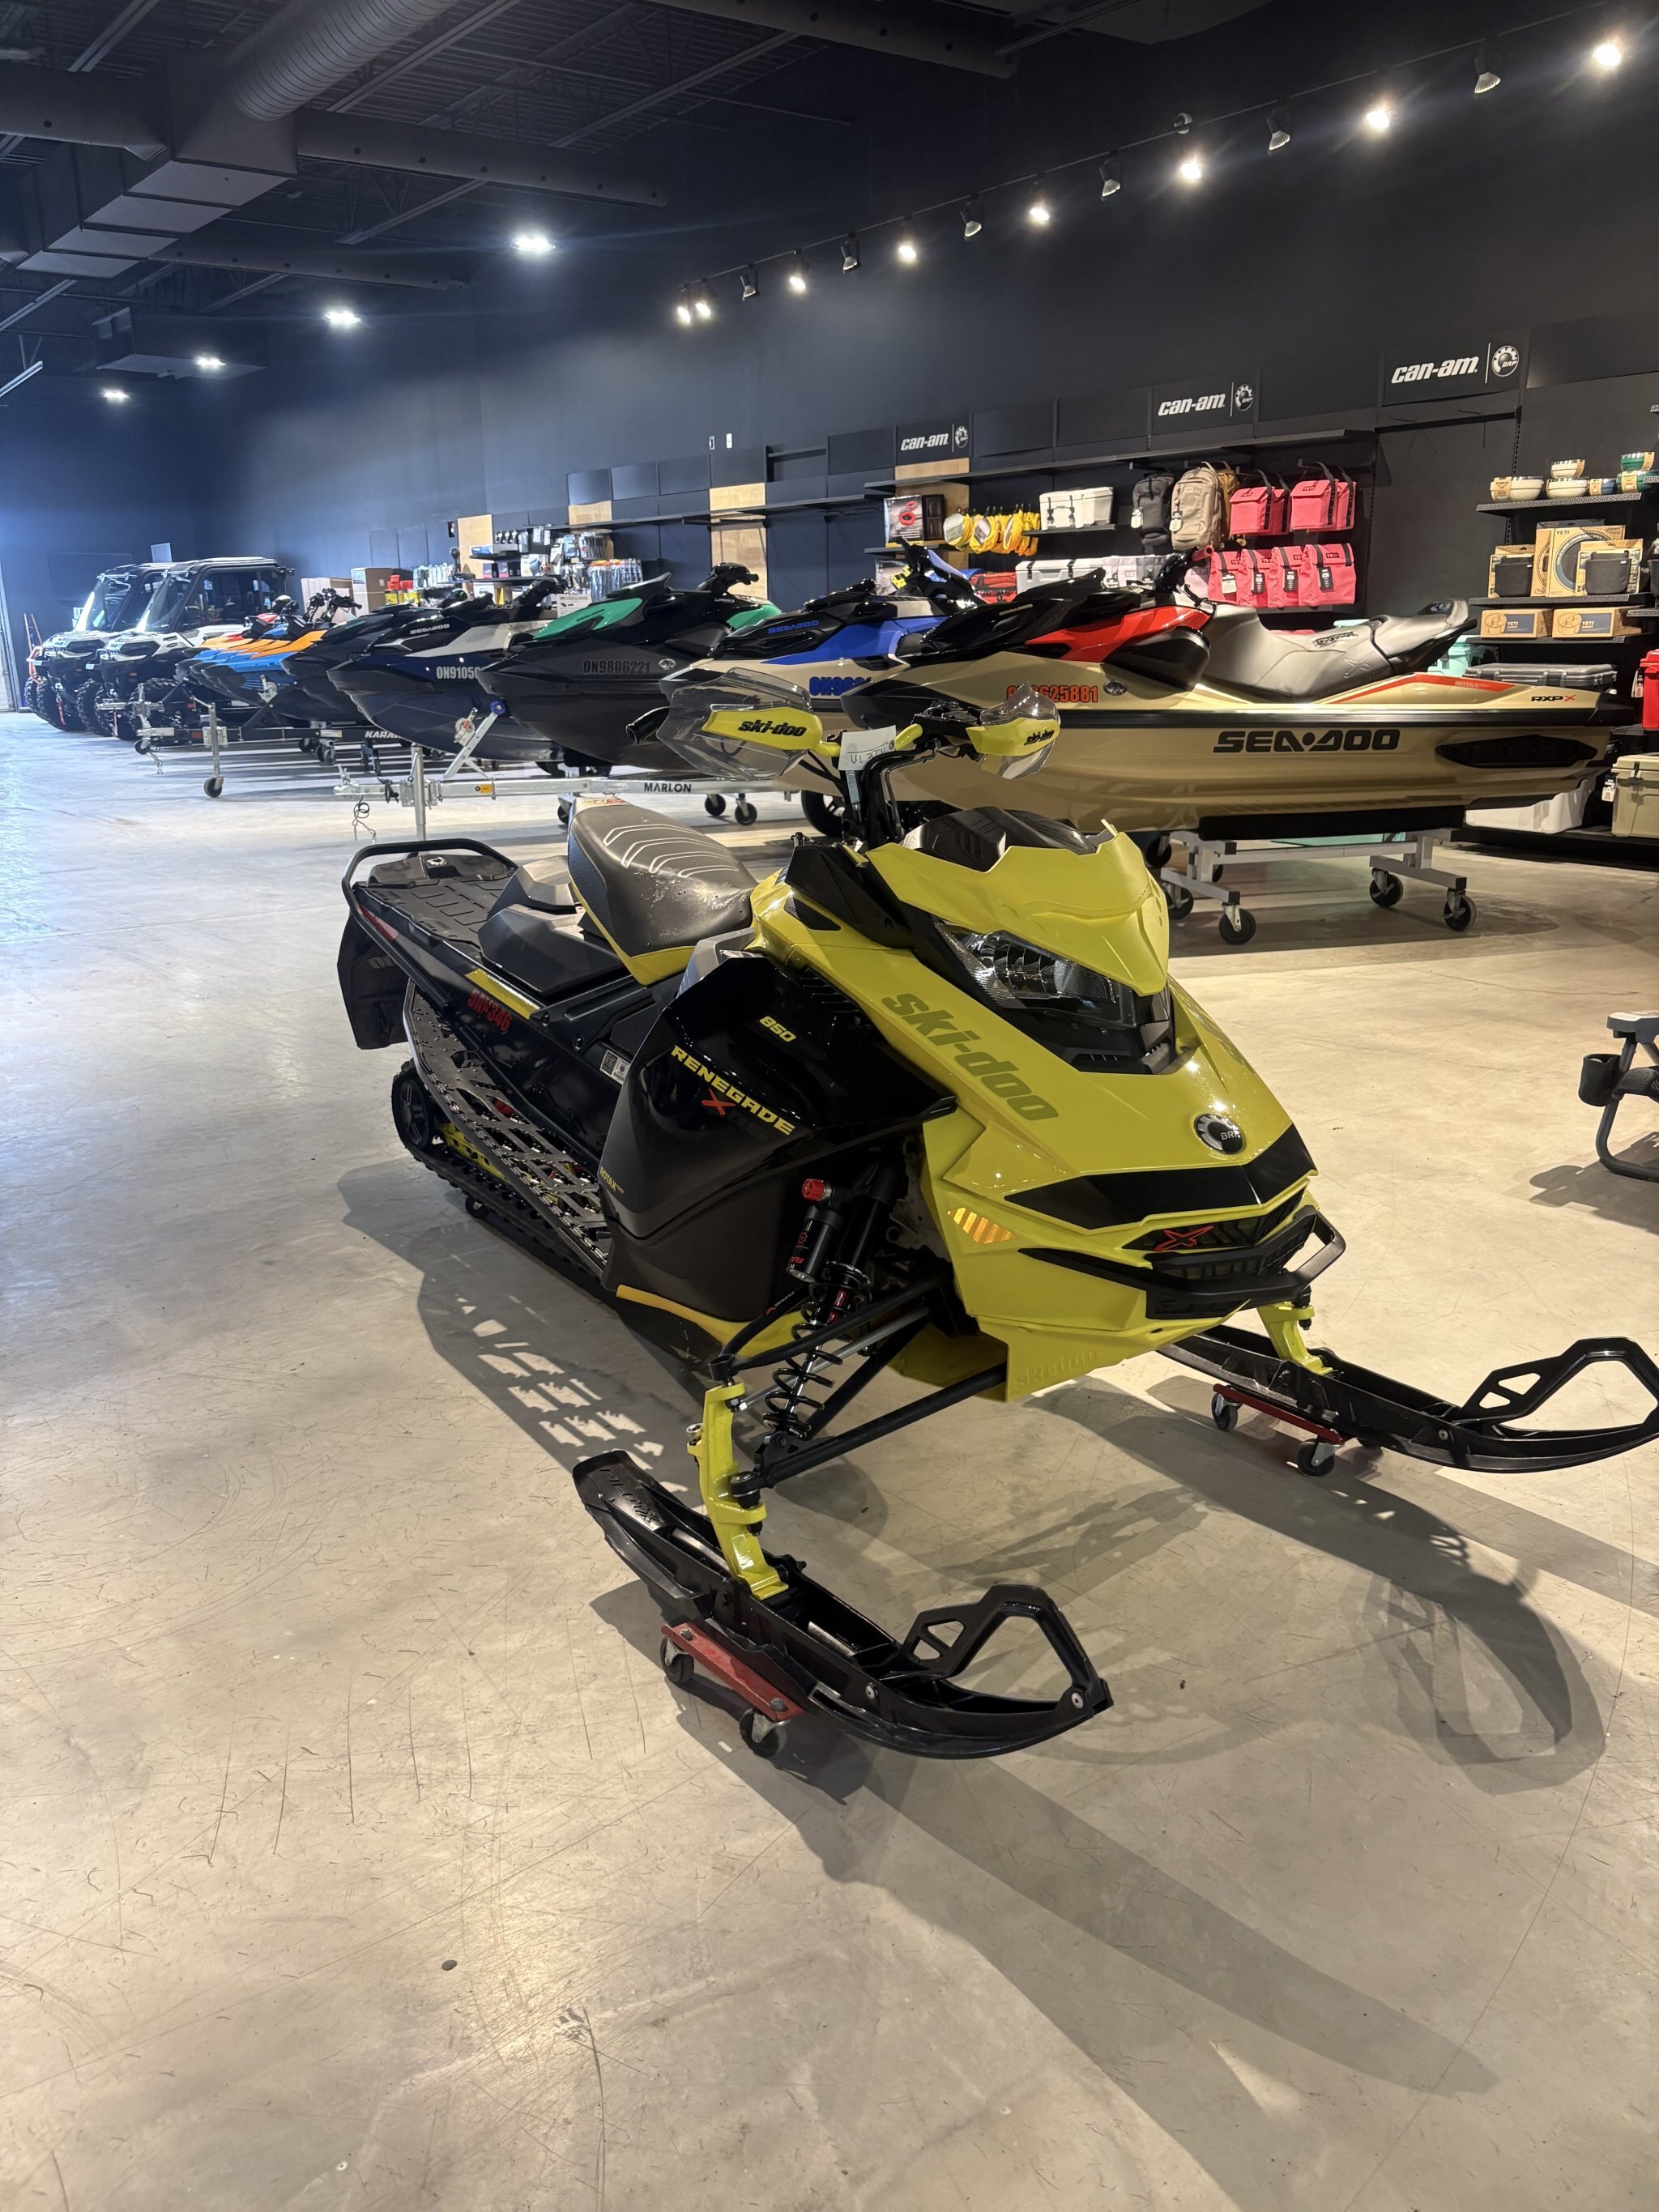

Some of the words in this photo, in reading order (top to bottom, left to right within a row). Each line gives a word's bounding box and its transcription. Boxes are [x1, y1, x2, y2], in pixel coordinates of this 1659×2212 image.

[1391, 356, 1479, 384] can-am
[1158, 393, 1226, 416] can-am
[901, 433, 949, 451] can-am
[738, 720, 807, 737] ski-doo
[644, 782, 692, 792] MARLON
[759, 1016, 796, 1042] 850
[881, 993, 1059, 1121] ski-doo
[671, 1045, 796, 1136] RENEGADE
